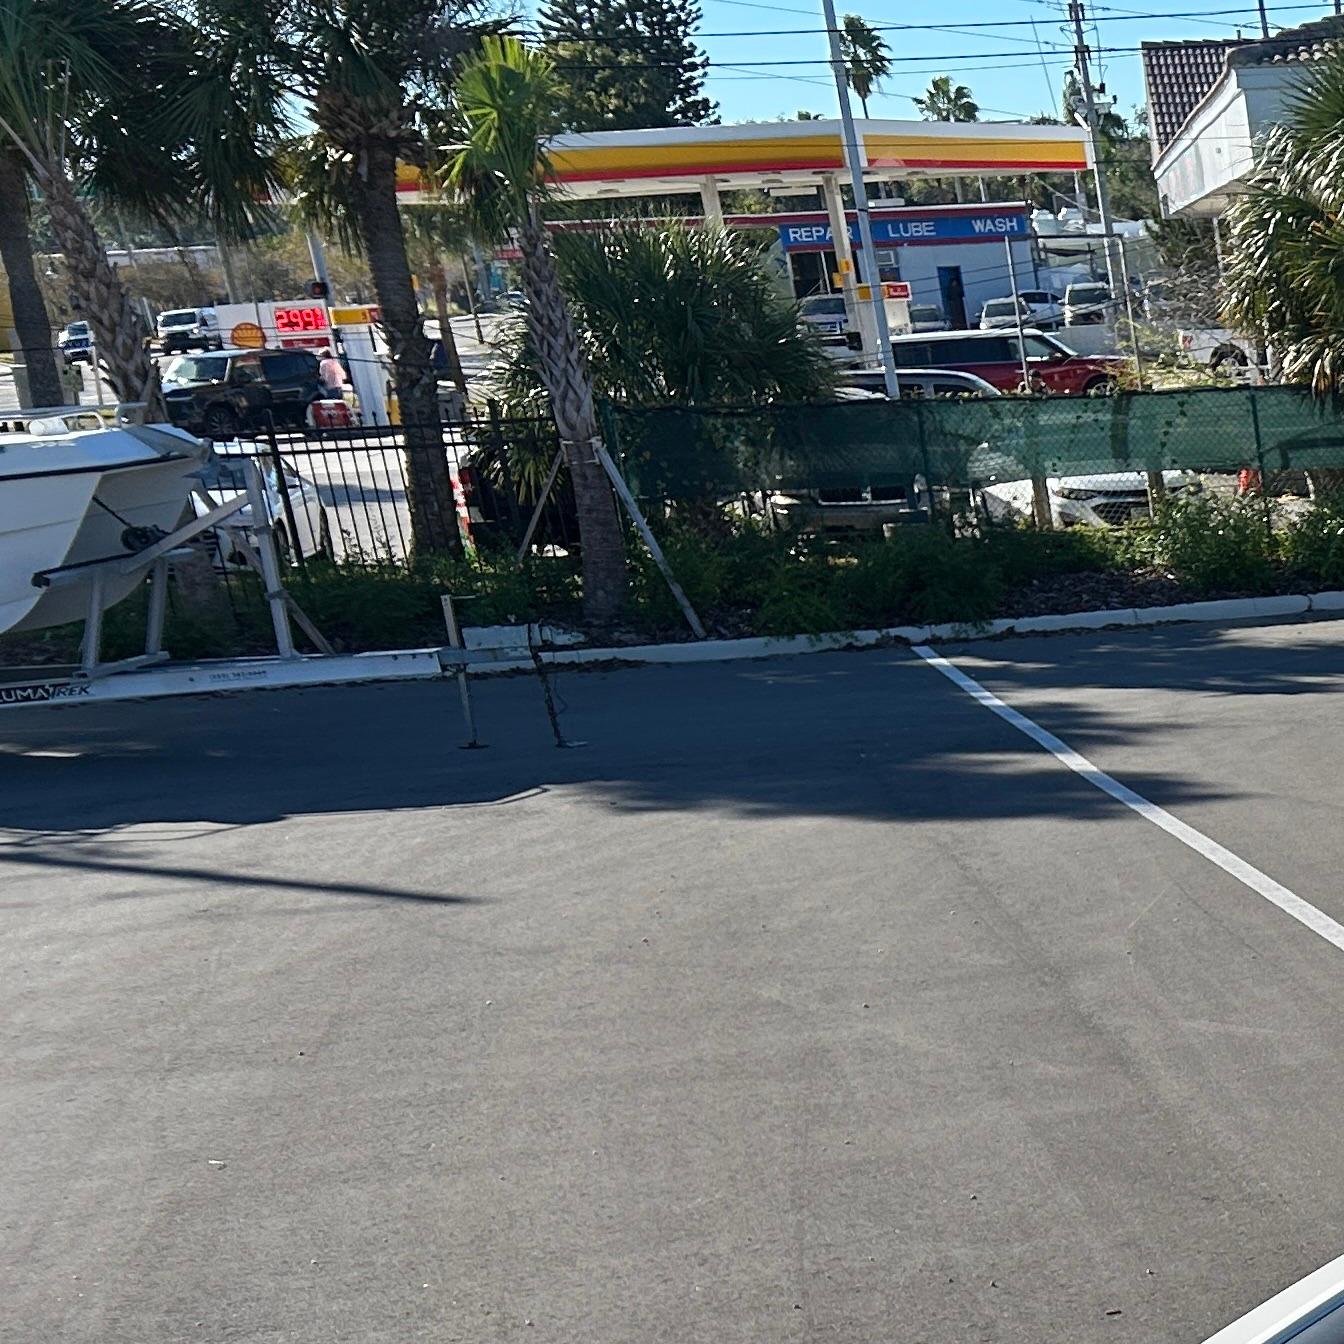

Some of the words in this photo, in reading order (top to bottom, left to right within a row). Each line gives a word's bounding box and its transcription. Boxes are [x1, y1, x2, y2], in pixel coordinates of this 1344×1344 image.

[788, 225, 853, 243] REPAR
[887, 221, 937, 238] LUBE
[971, 215, 1018, 234] WASH
[0, 683, 92, 702] UMATREK
